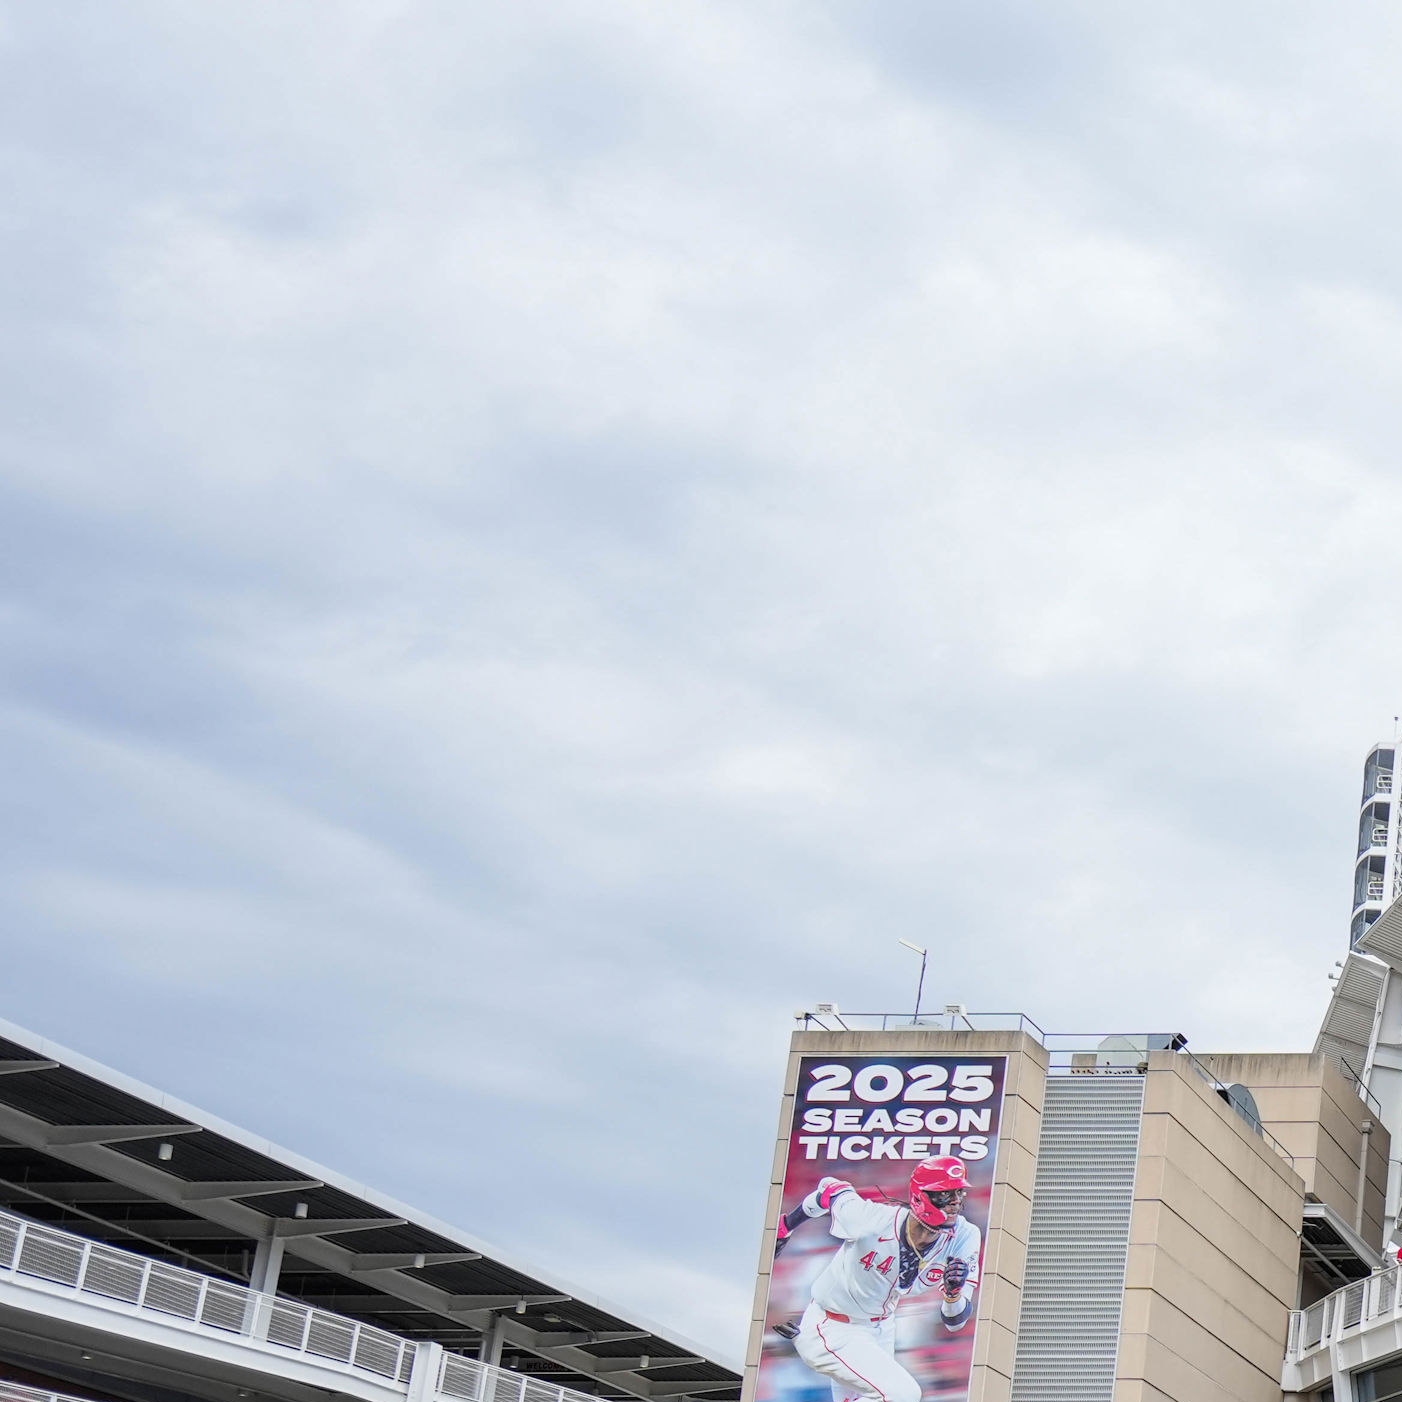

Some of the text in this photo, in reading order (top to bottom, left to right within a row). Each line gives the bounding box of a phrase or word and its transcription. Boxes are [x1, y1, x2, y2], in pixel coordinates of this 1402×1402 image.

[805, 1064, 995, 1103] 2025
[801, 1107, 992, 1133] SEASON
[799, 1135, 989, 1161] TICKETS
[860, 1250, 897, 1276] 44
